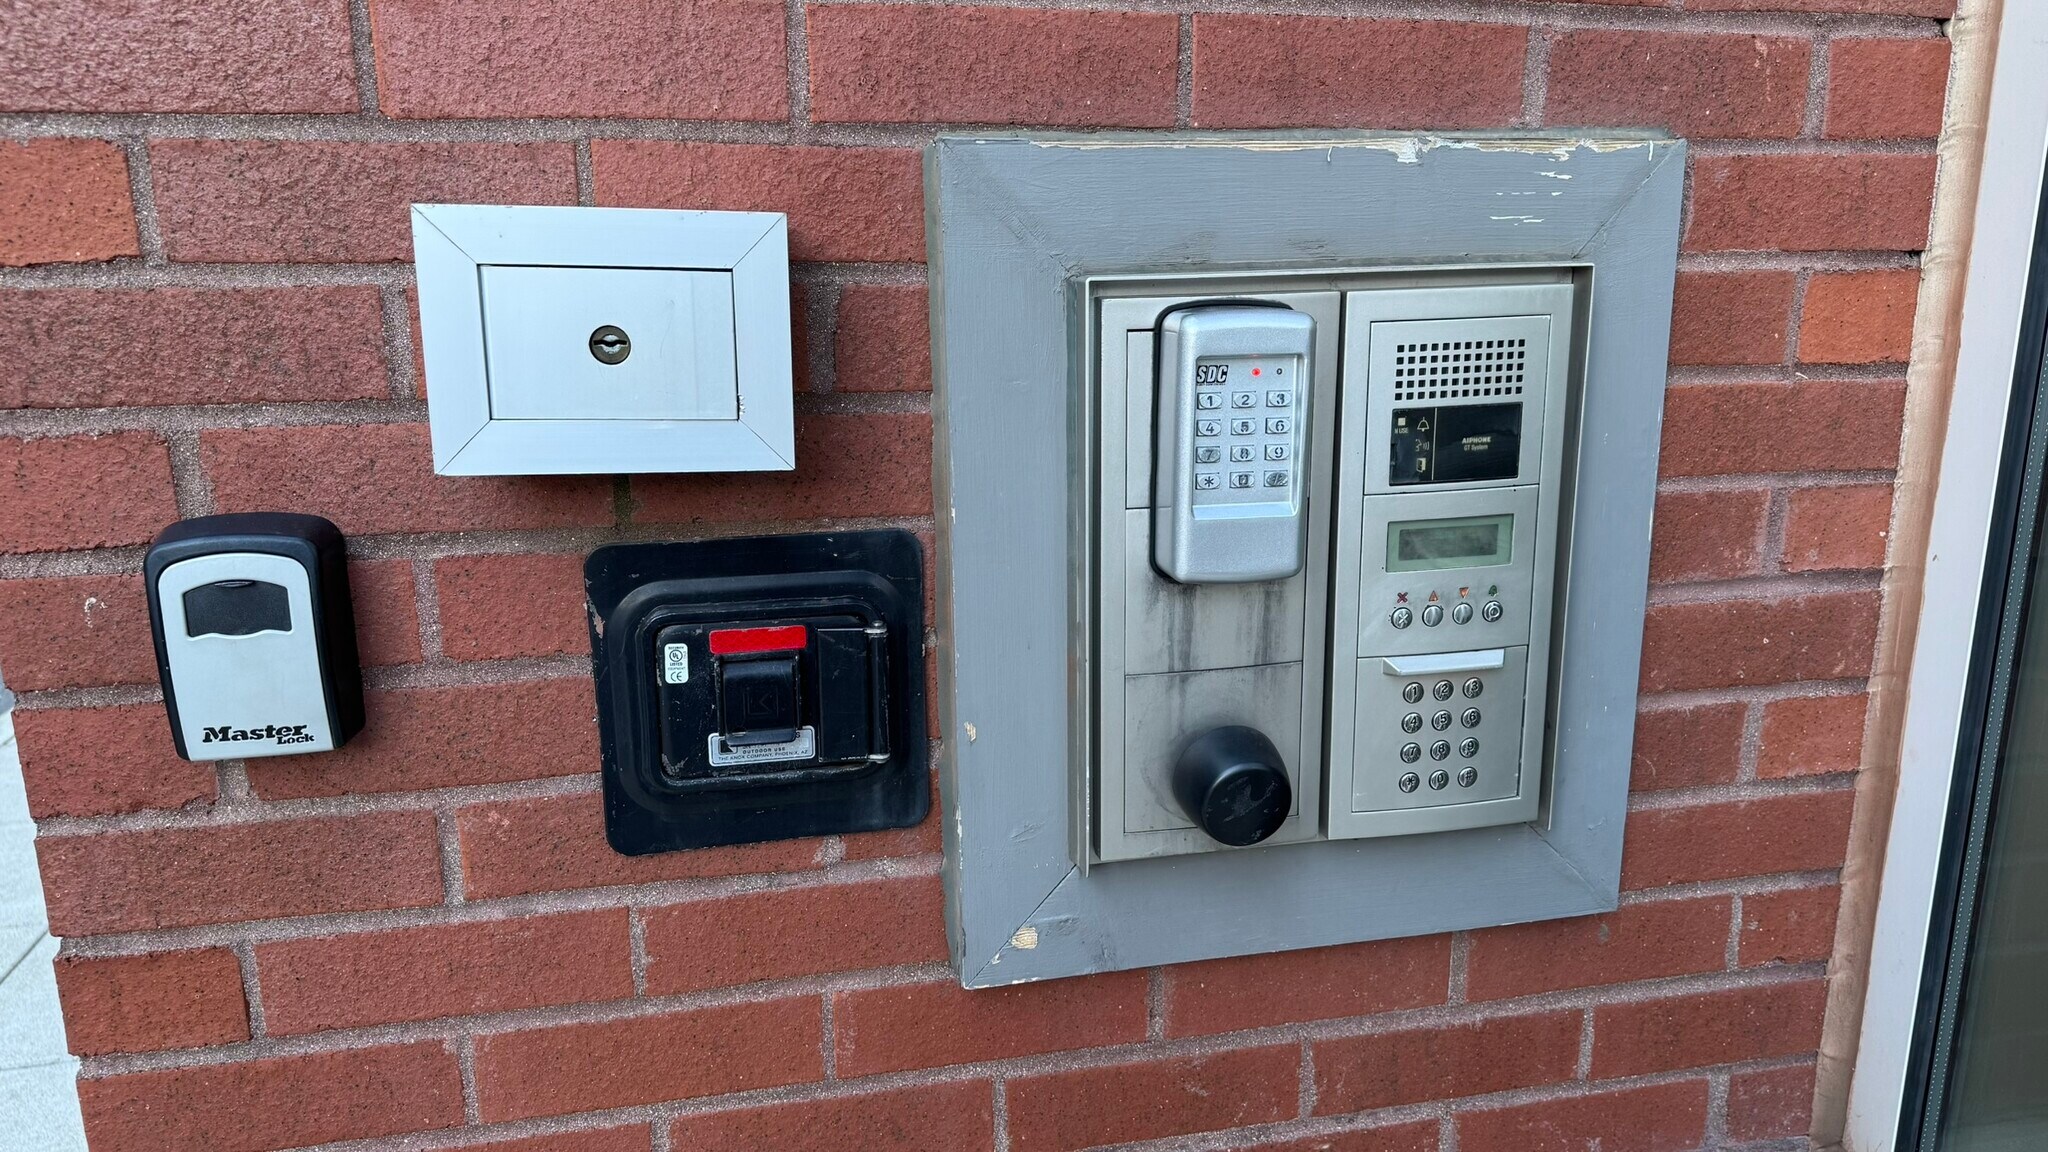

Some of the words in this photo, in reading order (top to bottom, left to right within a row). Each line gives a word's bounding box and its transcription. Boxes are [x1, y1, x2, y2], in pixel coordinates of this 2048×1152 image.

[1196, 365, 1228, 384] SDC
[1207, 395, 1213, 407] 1
[1241, 394, 1250, 406] 2
[1276, 393, 1285, 405] 3
[1206, 422, 1214, 434] 4
[1240, 421, 1249, 432] 5
[1276, 420, 1285, 431] 6
[1205, 449, 1214, 461] 7
[1240, 448, 1249, 459] 8
[1274, 447, 1284, 458] 9
[670, 671, 682, 682] CE
[203, 725, 307, 742] Master
[276, 733, 315, 745] Lock
